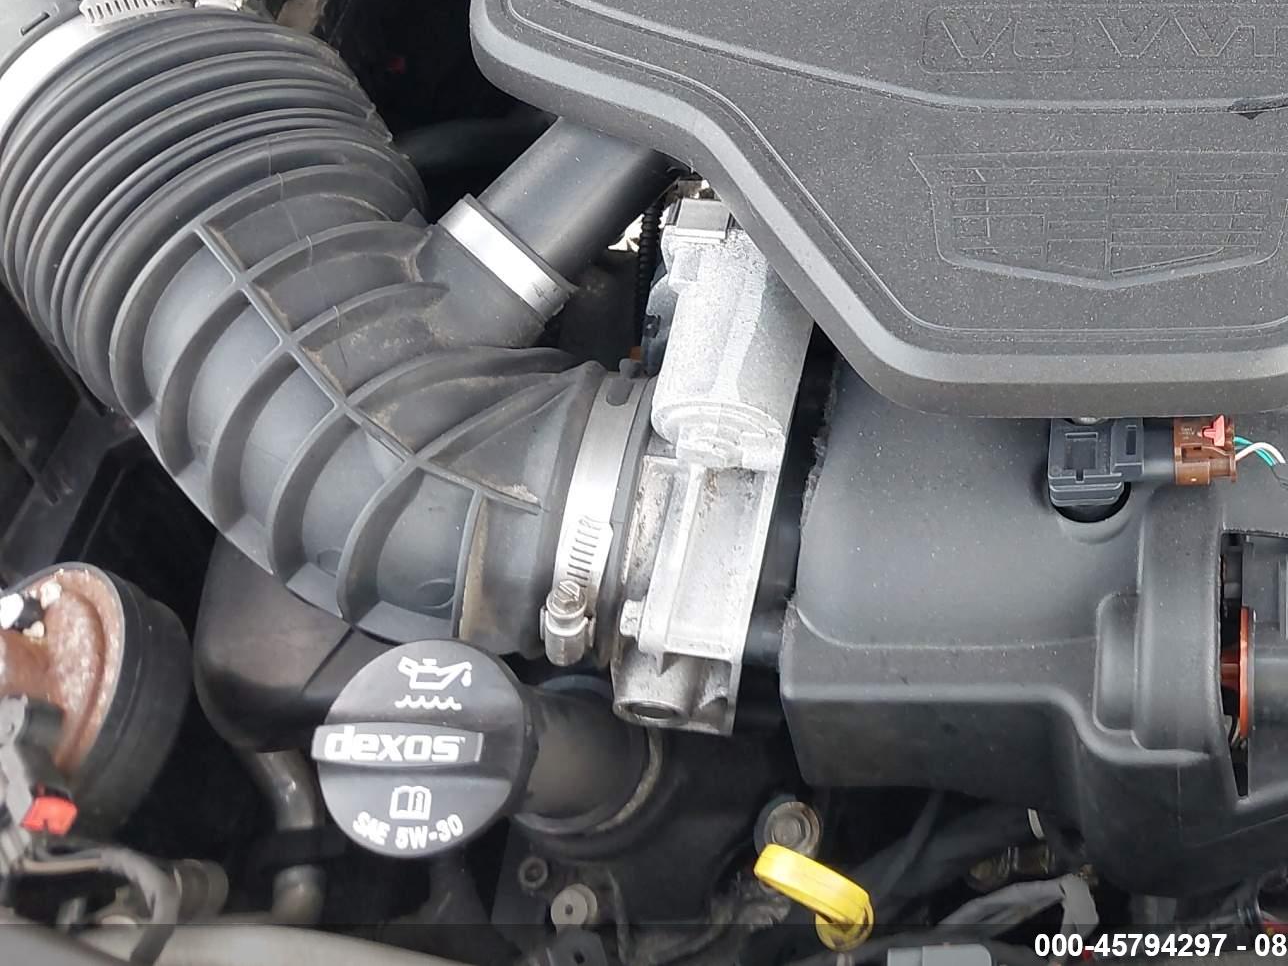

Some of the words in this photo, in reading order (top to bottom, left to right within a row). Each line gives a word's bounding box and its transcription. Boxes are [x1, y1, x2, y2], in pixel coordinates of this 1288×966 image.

[940, 17, 1074, 59] V6
[324, 725, 460, 762] dexos
[353, 811, 391, 845] SAE
